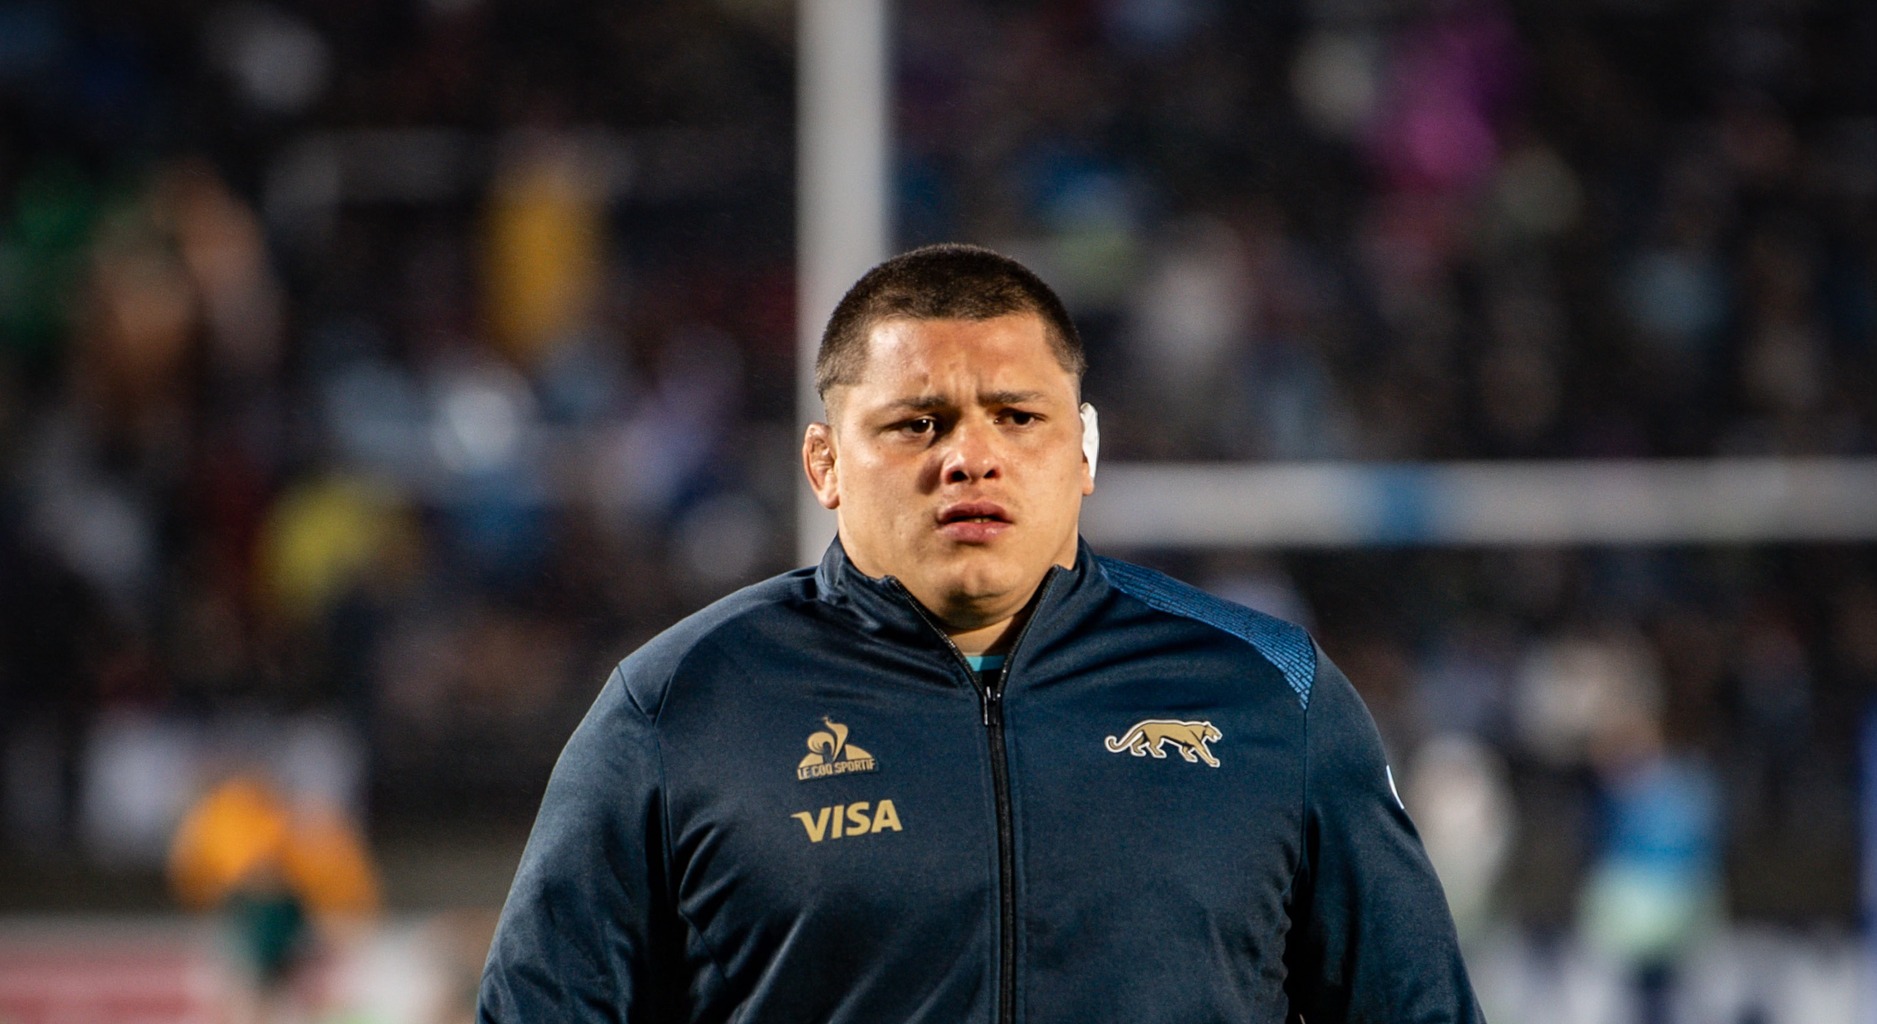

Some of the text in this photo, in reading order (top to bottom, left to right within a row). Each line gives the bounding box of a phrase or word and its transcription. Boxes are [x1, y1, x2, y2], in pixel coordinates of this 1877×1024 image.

[797, 758, 876, 780] LE COQ SPORTIF
[790, 799, 903, 842] VISA
